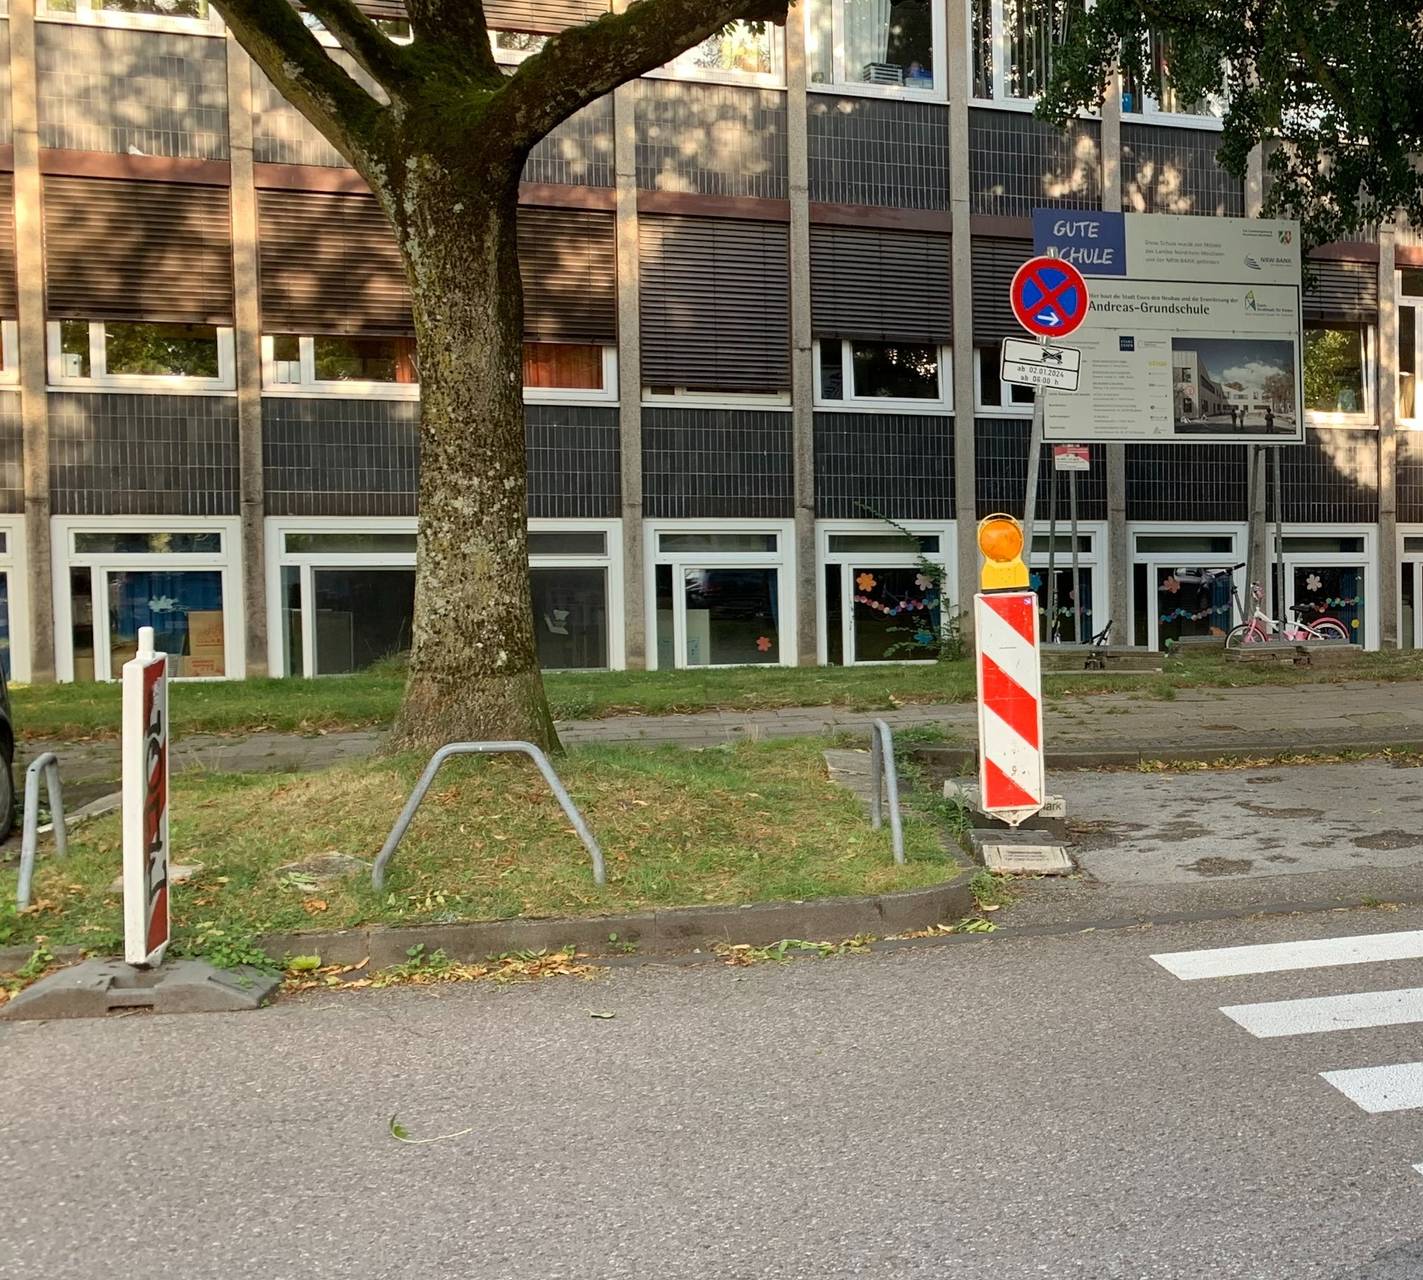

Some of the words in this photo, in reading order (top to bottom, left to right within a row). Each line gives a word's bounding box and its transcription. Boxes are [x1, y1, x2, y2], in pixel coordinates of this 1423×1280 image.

[1053, 220, 1100, 238] GUTE
[1058, 246, 1115, 265] CHULE
[1088, 301, 1210, 315] Andreas-Grundschule
